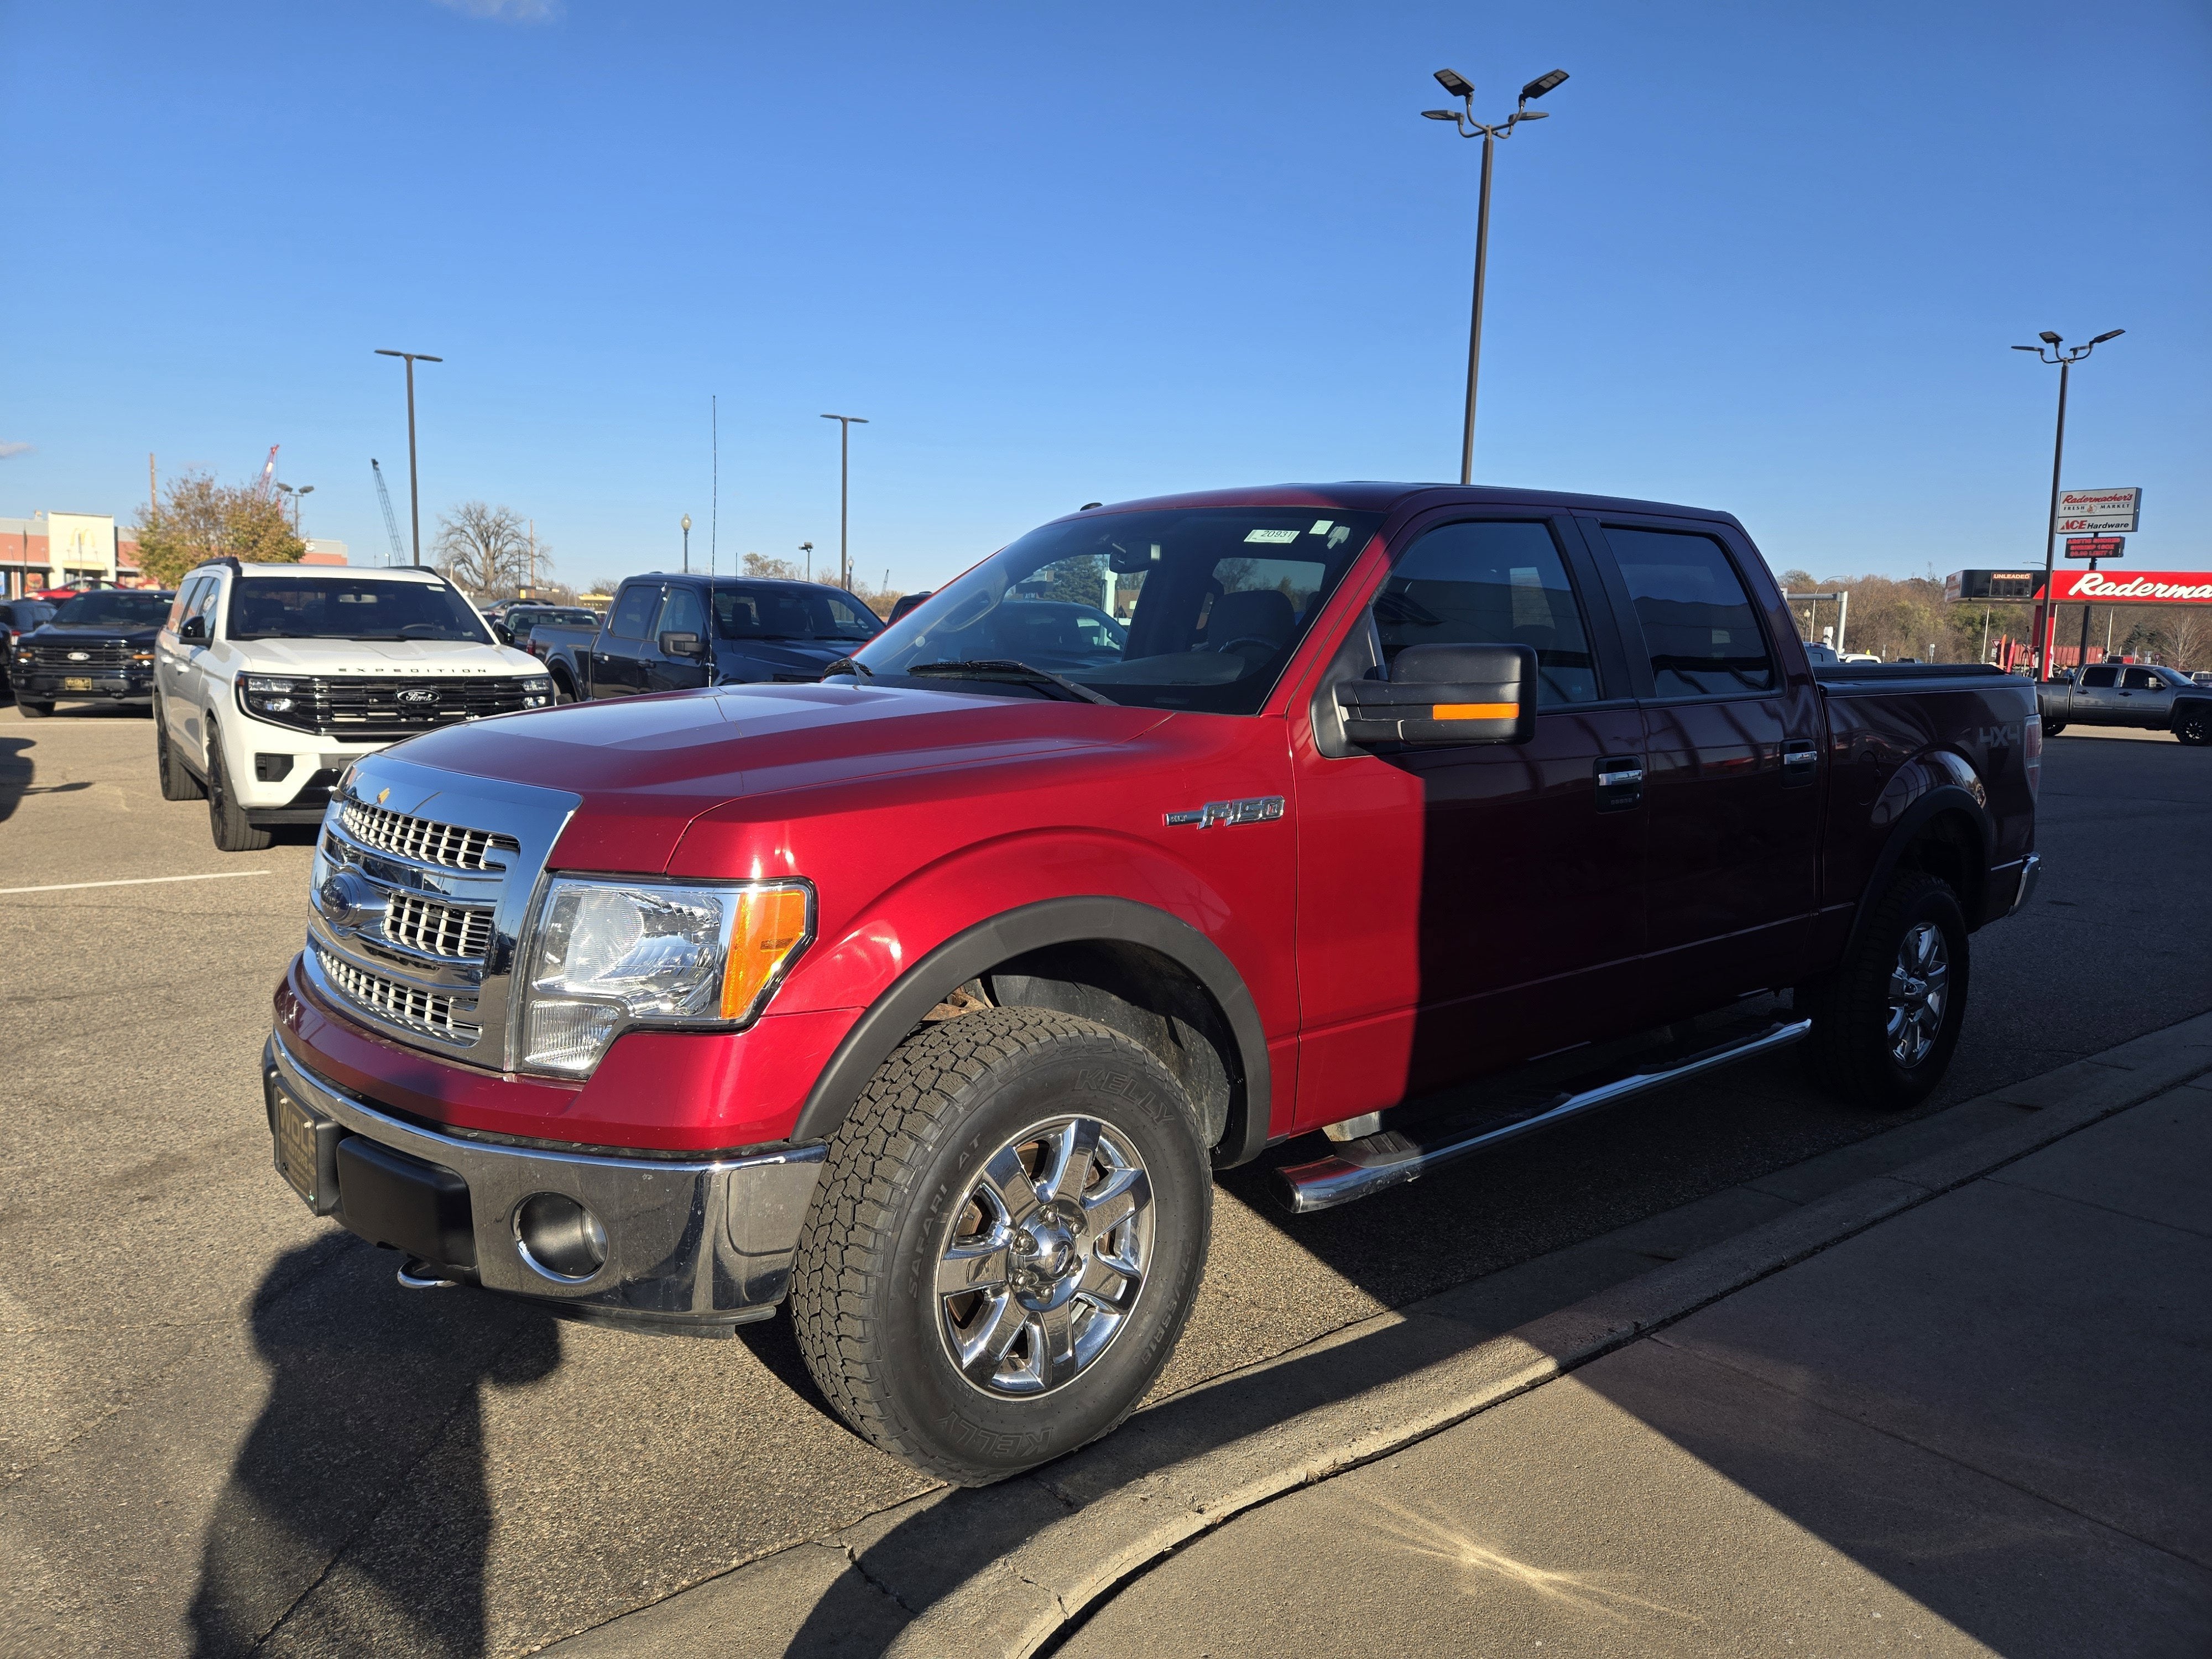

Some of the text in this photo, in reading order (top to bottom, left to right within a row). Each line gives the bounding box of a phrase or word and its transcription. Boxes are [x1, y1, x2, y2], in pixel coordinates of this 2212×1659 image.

[2062, 493, 2133, 504] Radermacher's
[2060, 519, 2088, 530] ACE
[405, 692, 433, 702] Ford
[1074, 1068, 1176, 1125] KELLY
[280, 1103, 316, 1158] WOLF
[908, 1134, 980, 1298] SAFARI AT
[937, 1411, 1052, 1458] KELLY
